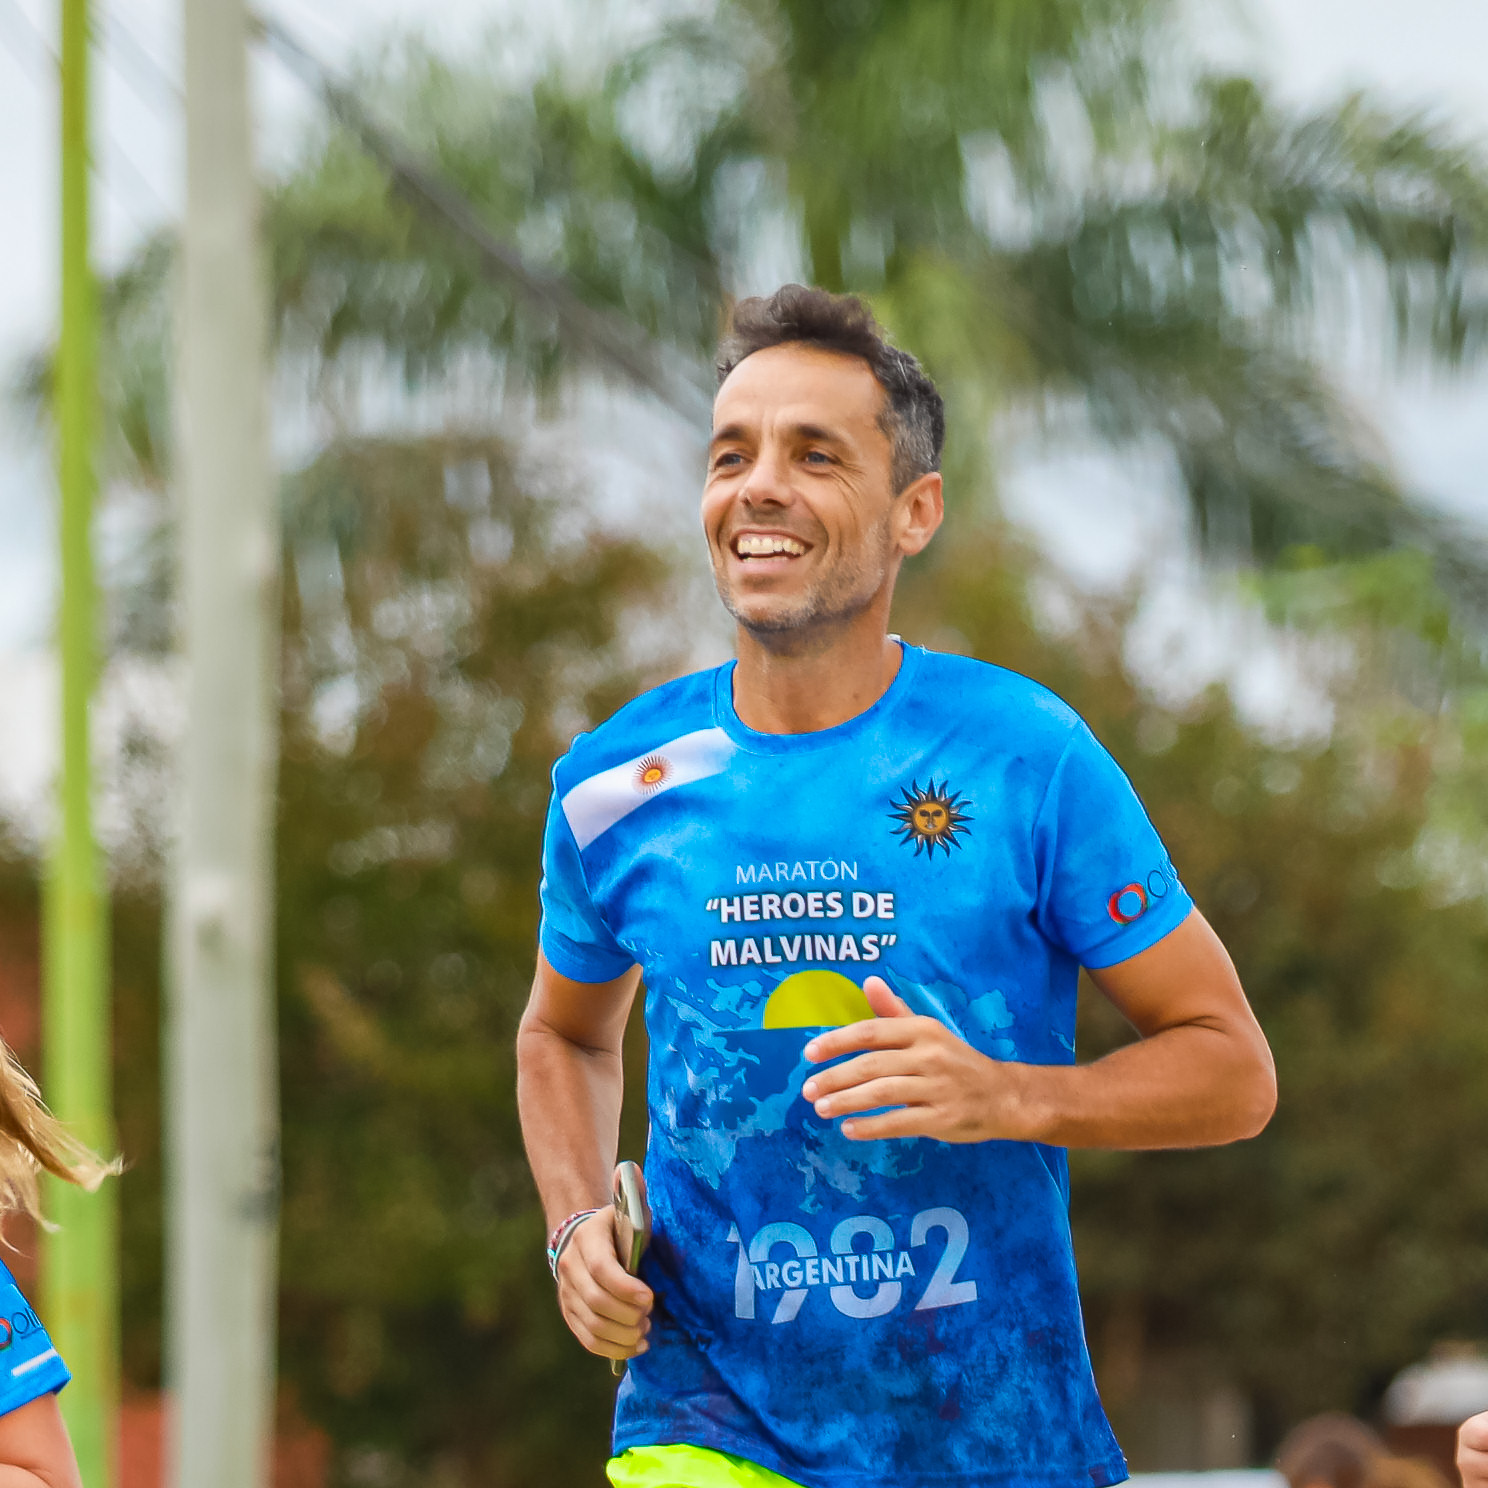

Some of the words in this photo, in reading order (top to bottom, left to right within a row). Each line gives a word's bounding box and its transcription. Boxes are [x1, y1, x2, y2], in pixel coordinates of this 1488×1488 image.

[852, 891, 895, 919] DE
[726, 1206, 978, 1325] 1982
[749, 1251, 916, 1290] ARGENTINA
